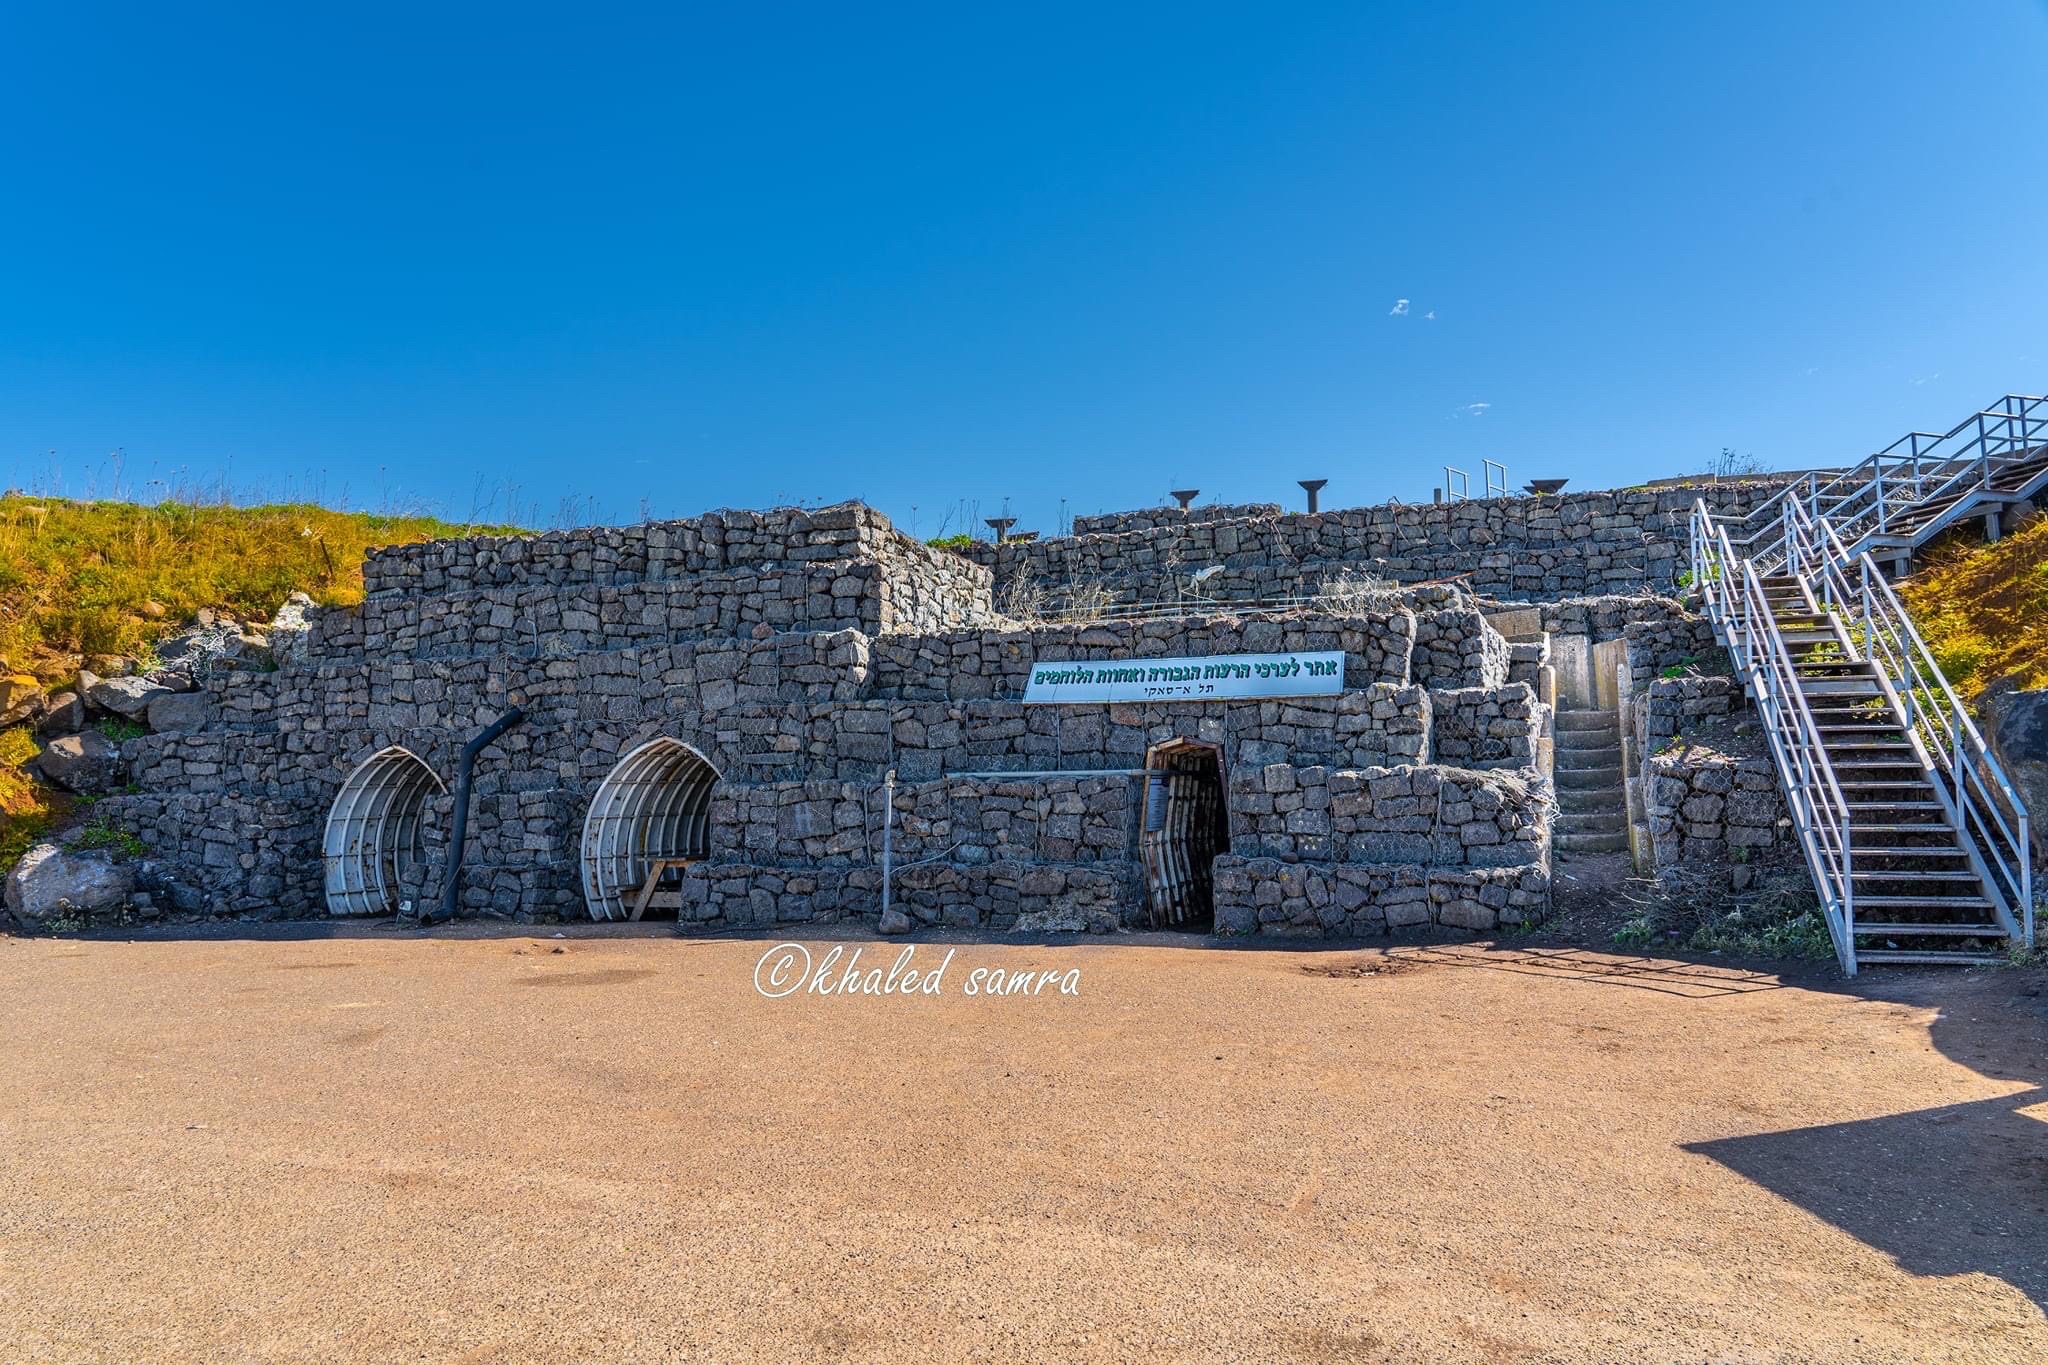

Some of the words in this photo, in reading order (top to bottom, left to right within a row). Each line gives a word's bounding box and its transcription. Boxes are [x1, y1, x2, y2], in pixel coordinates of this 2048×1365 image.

[1034, 665, 1094, 685] הלוחמים
[1095, 667, 1145, 684] ואחוות
[1148, 665, 1202, 682] הגבורה
[1203, 663, 1250, 680] הרעות
[1254, 657, 1300, 678] לערכי
[1304, 660, 1338, 676] אתר
[1198, 683, 1214, 694] תל
